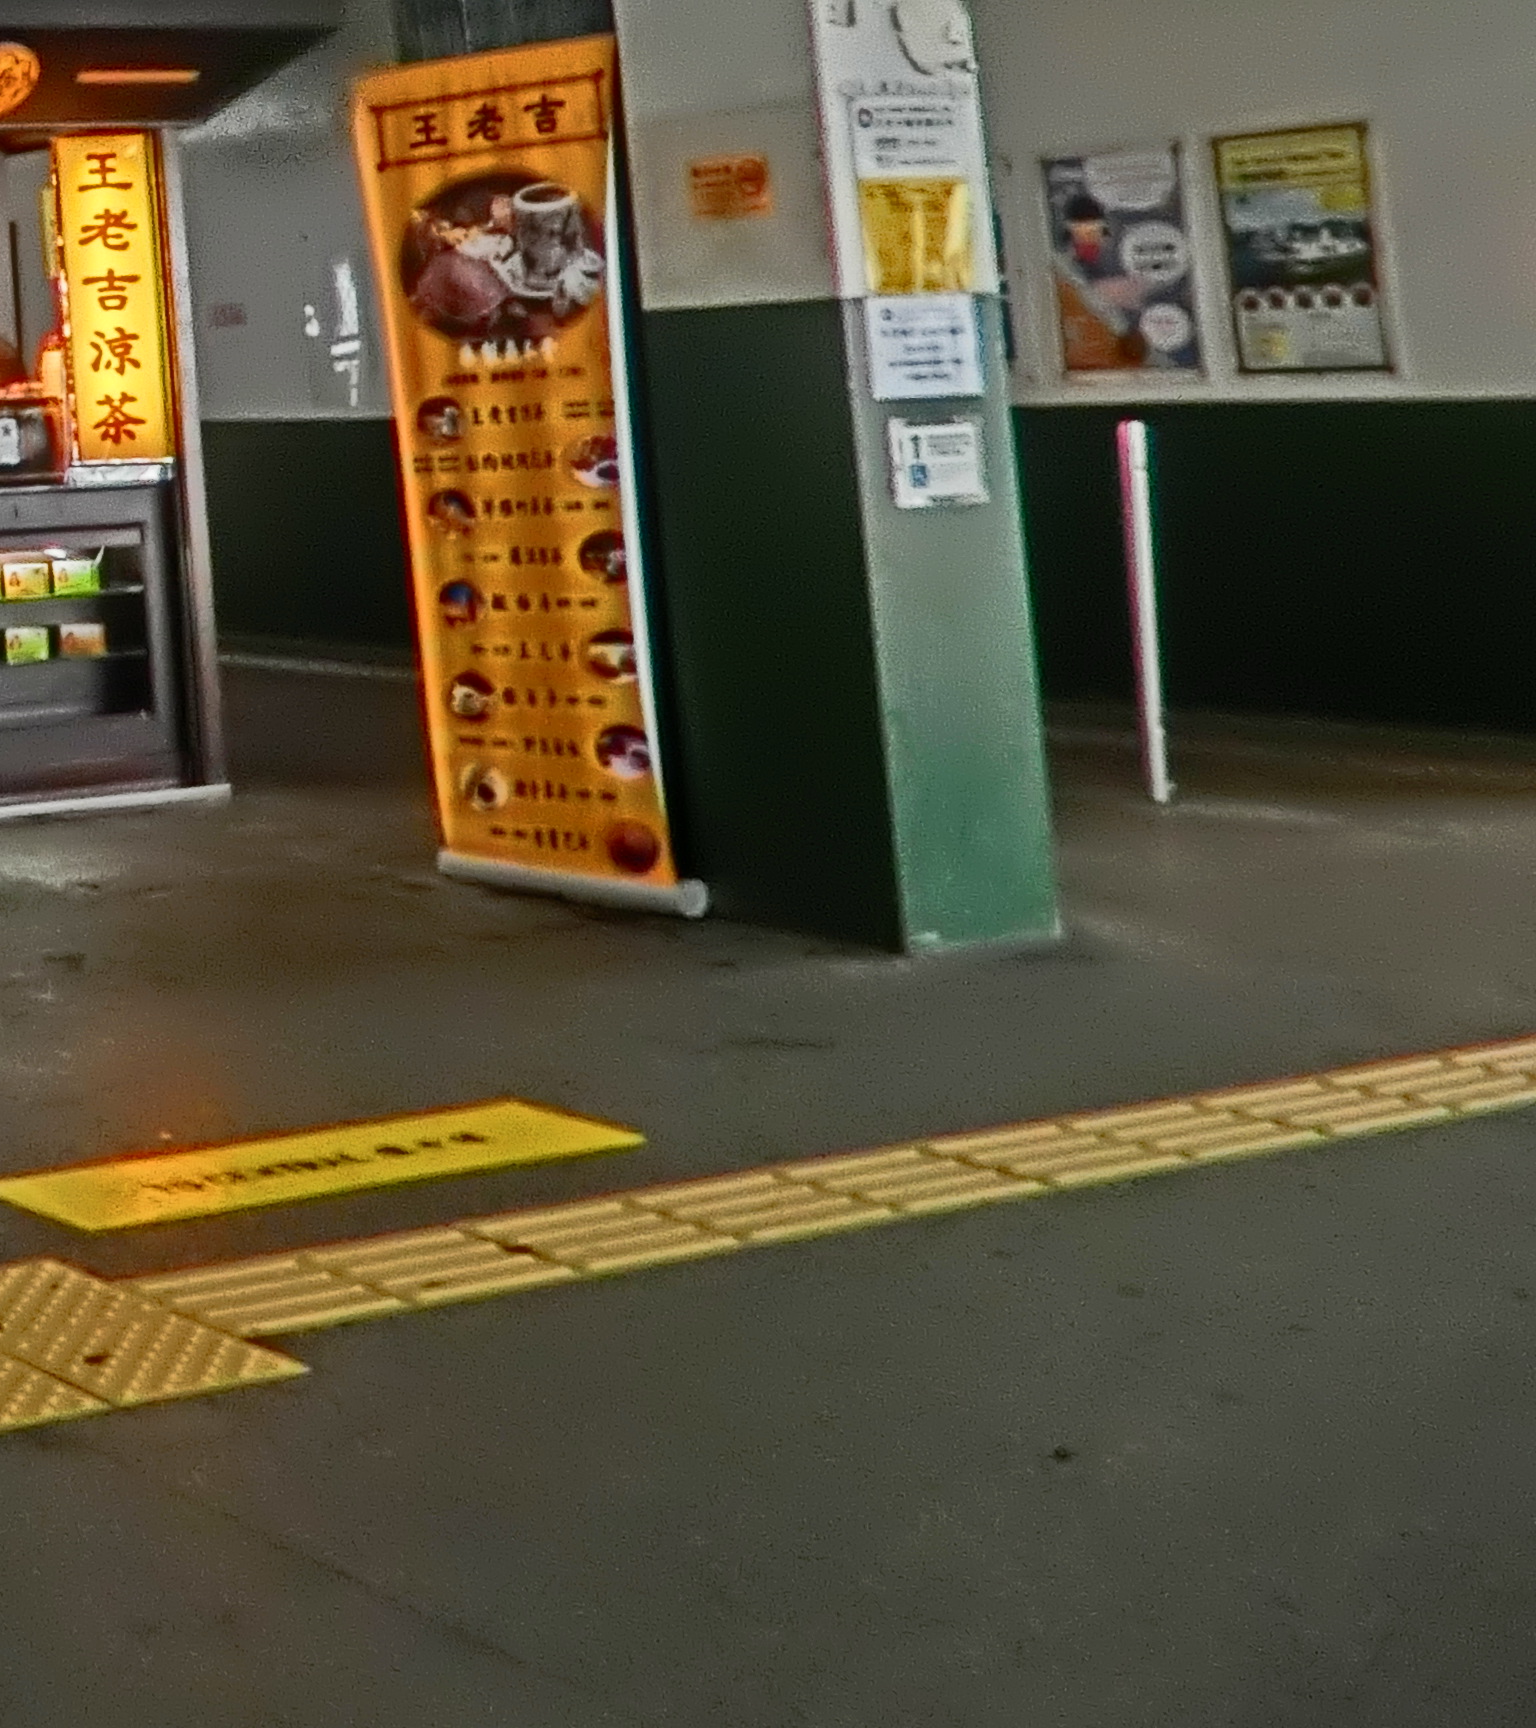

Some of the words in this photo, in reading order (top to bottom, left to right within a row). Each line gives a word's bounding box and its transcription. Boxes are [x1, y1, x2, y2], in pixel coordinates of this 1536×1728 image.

[409, 94, 566, 149] 王老吉
[77, 152, 147, 446] 王老吉涼茶
